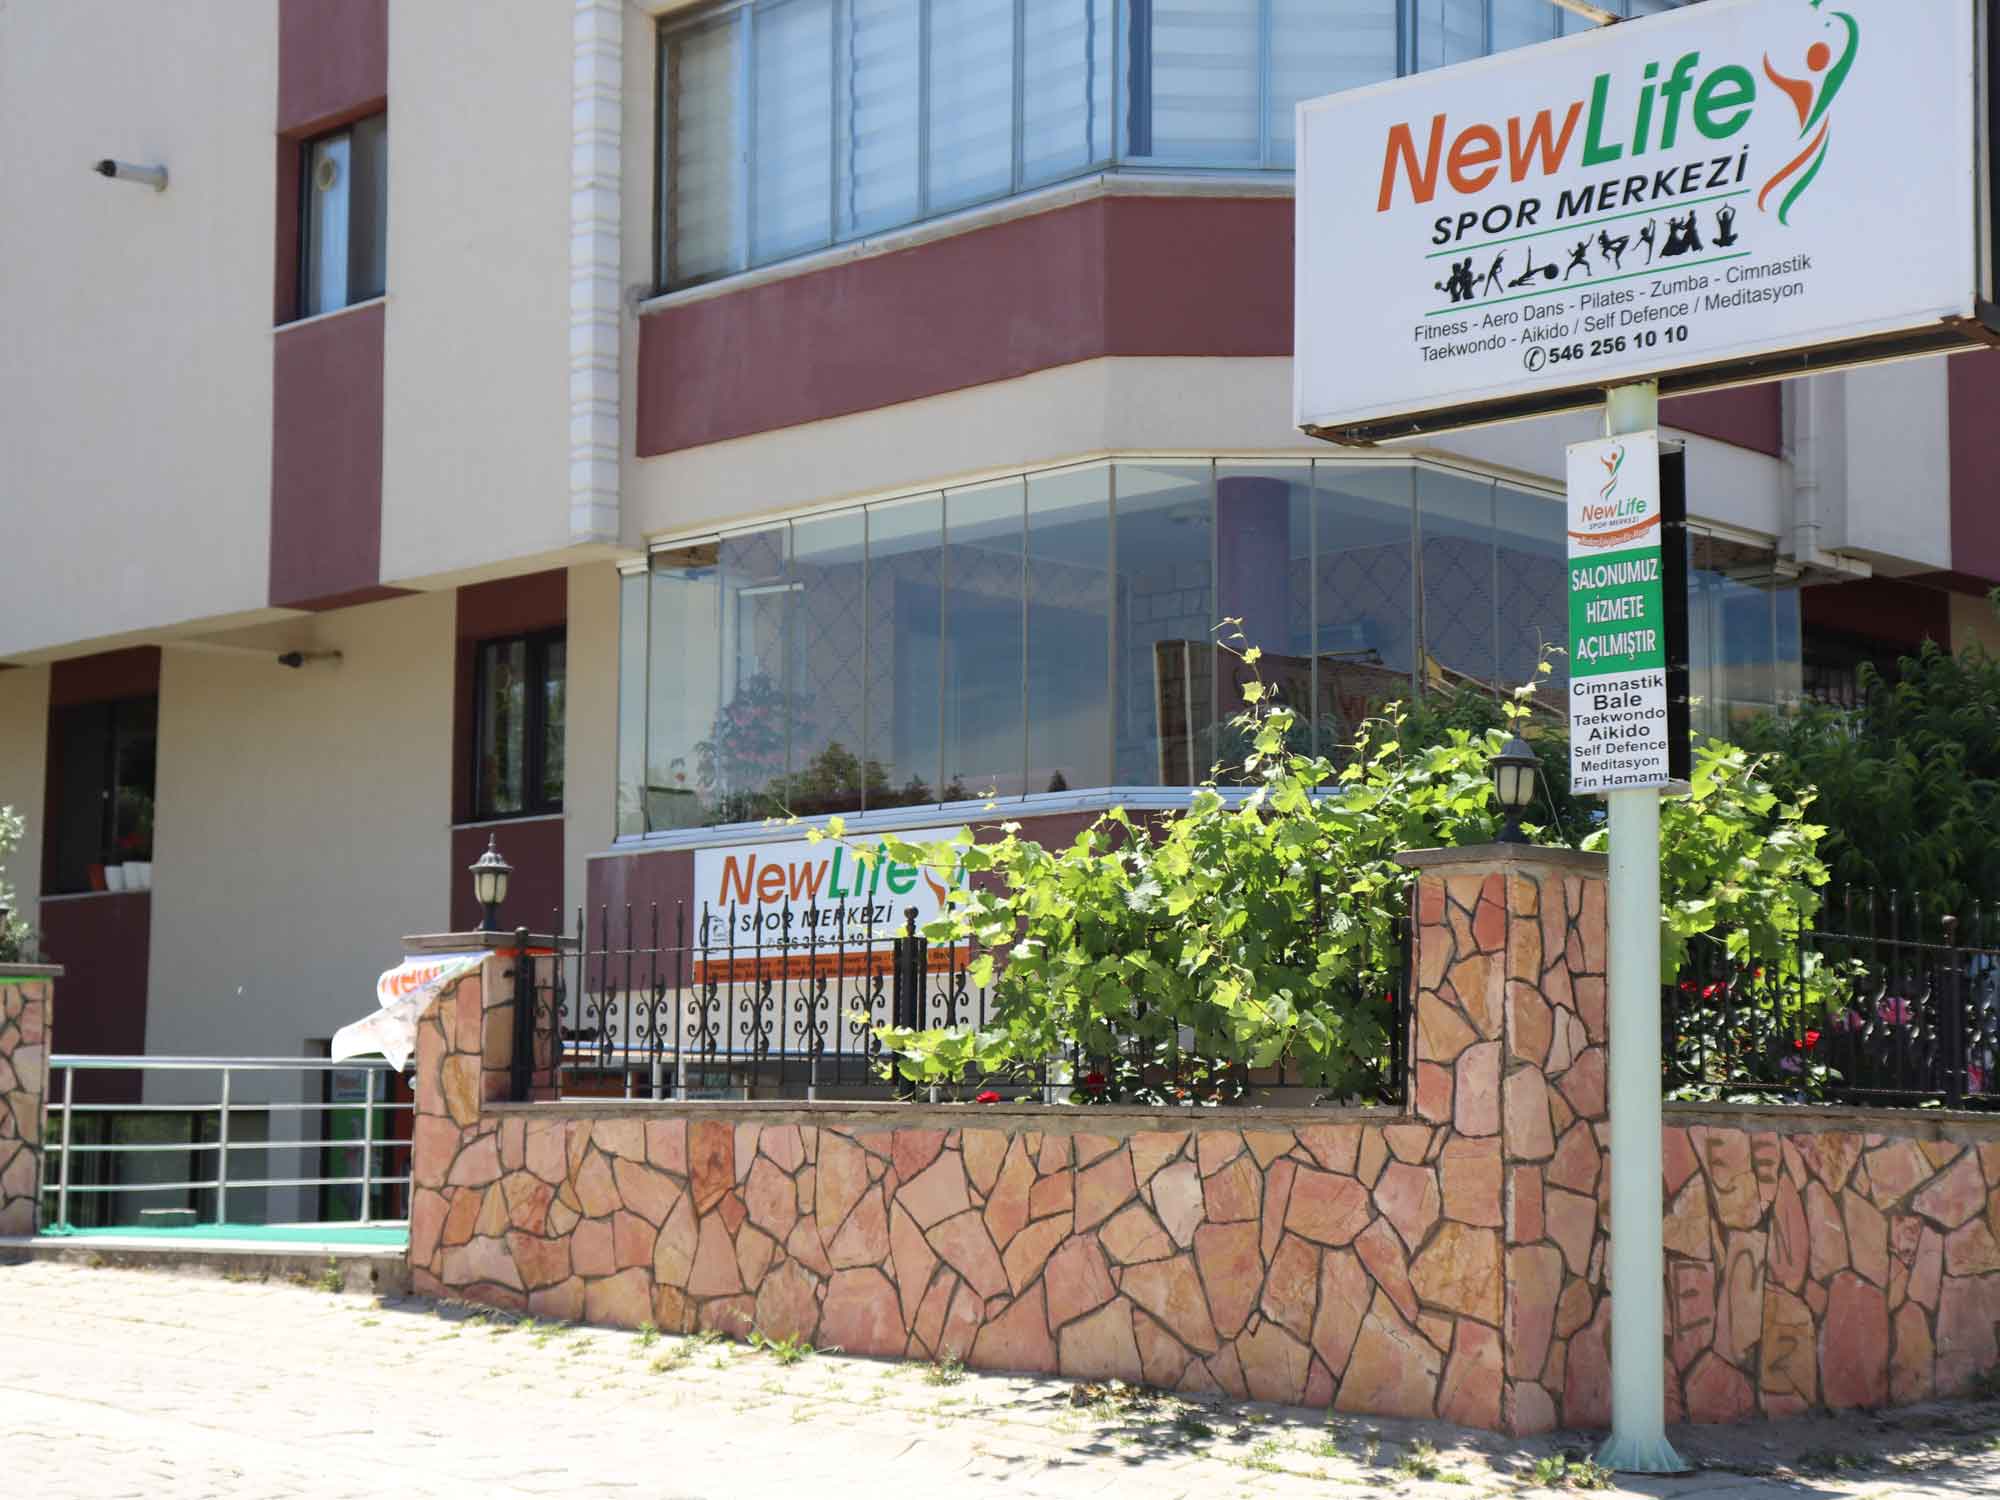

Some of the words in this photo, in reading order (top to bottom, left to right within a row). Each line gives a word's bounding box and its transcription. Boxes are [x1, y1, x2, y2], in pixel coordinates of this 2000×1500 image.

[1377, 51, 1756, 212] NewLife
[1431, 198, 1541, 245] SPOR
[1556, 144, 1750, 220] MERKEZİ
[1414, 319, 1468, 342] Fitness
[1482, 311, 1519, 329] Aero
[1524, 301, 1564, 321] Dans
[1580, 289, 1634, 311] Pilates
[1650, 275, 1709, 299] Zumba
[1726, 254, 1813, 284] Cimnastik
[1419, 334, 1506, 362] Taekwondo
[1520, 321, 1569, 345] Aikido
[1584, 312, 1616, 333] Self
[1620, 302, 1689, 327] Defence
[1705, 281, 1804, 312] Meditasyon
[1549, 342, 1584, 364] 546
[1590, 335, 1626, 357] 256
[1633, 330, 1657, 349] 10
[1664, 324, 1688, 343] 10
[1582, 497, 1647, 523] NewLife
[1571, 558, 1659, 592] SALONUMUZ
[1586, 594, 1645, 624] HİZMETE
[1576, 629, 1657, 665] AÇILMIŞTIR
[1573, 674, 1664, 696] Cimnastik
[1593, 691, 1643, 711] Bale
[1573, 707, 1666, 727] Taekwondo
[1588, 723, 1651, 741] Aikido
[1574, 743, 1601, 757] Self
[1605, 740, 1666, 755] Defence
[1581, 757, 1660, 773] Meditasyon
[1574, 776, 1598, 789] Fin
